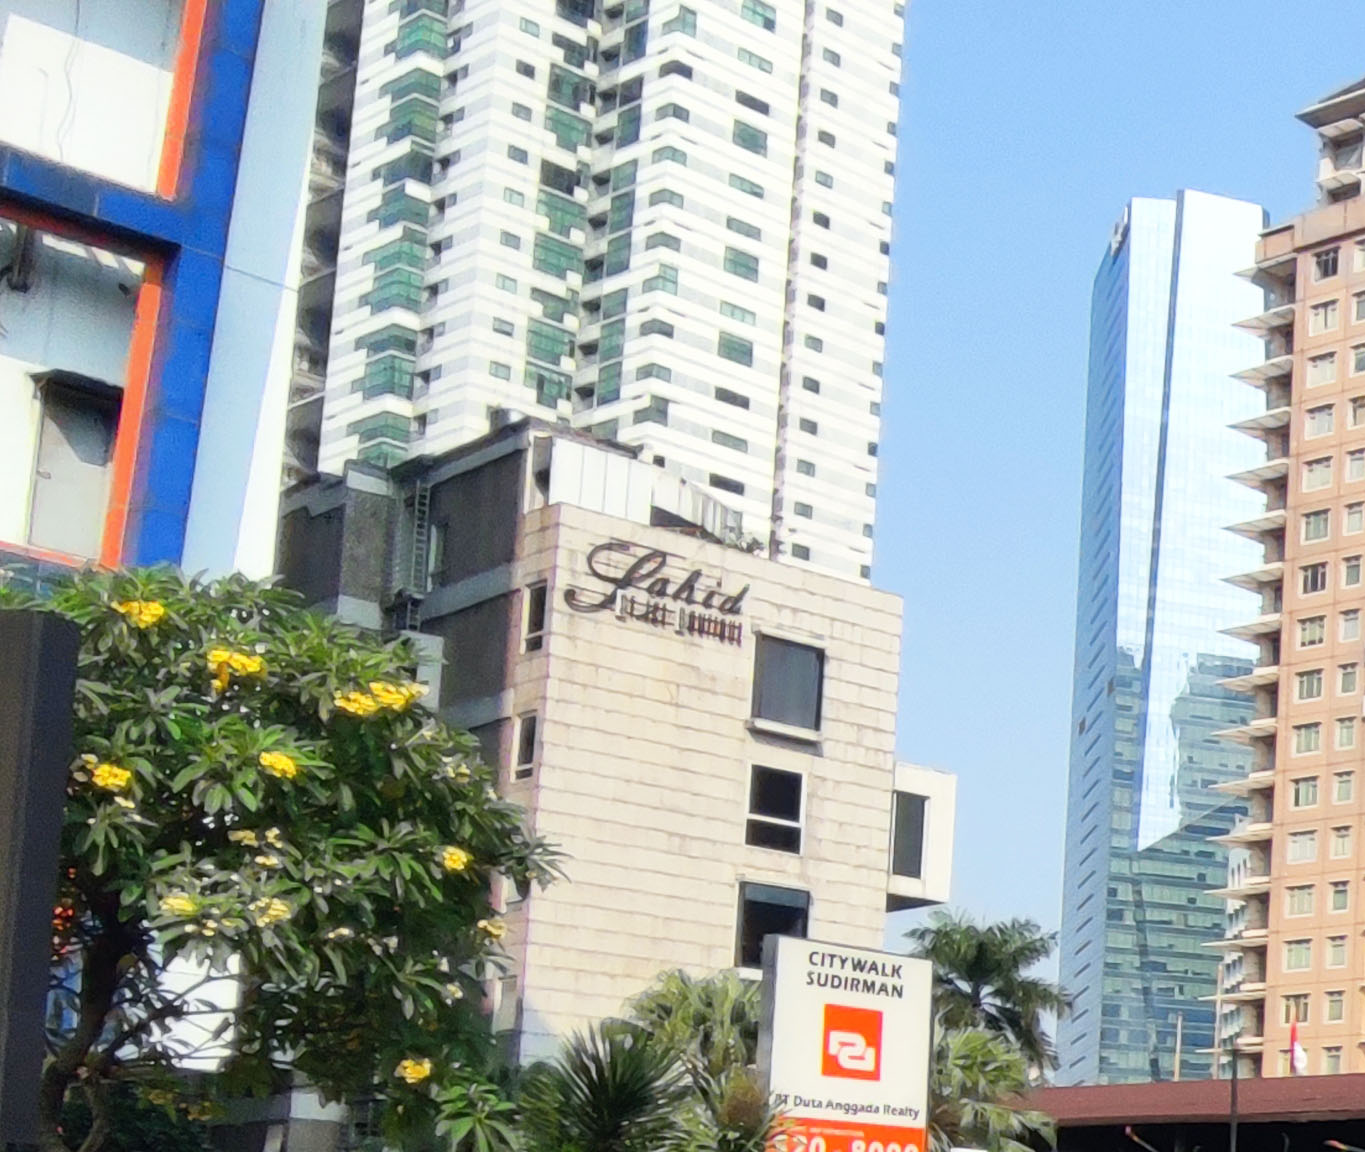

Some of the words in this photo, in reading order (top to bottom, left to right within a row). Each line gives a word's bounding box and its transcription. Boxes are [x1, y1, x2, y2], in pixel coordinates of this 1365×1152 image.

[806, 970, 904, 999] SUDIRMAN
[793, 1095, 823, 1108] Duta
[825, 1098, 880, 1115] Anggada
[883, 1104, 920, 1120] Realty
